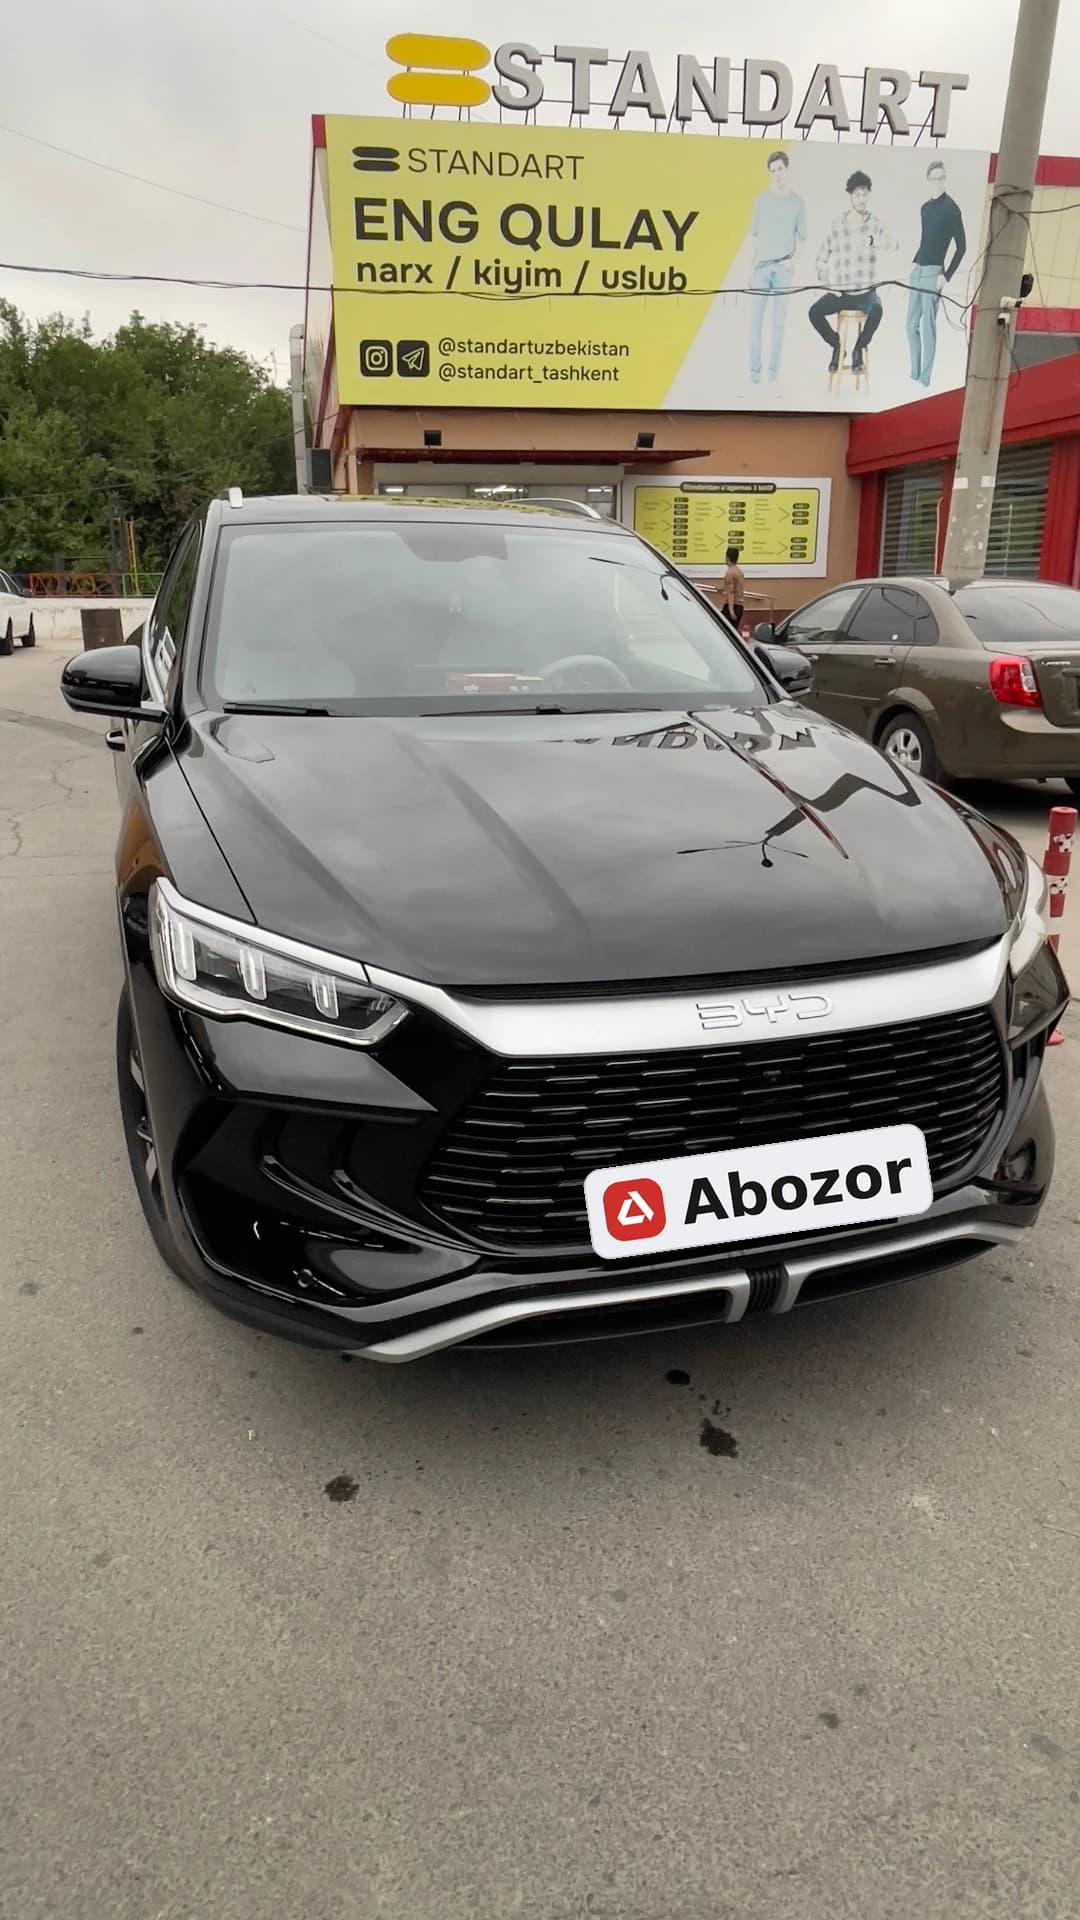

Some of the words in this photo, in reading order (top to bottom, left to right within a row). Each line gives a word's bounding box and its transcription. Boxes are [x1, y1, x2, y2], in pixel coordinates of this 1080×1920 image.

[491, 42, 969, 138] STANDART
[408, 147, 585, 180] STANDART
[354, 197, 479, 244] ENG
[500, 203, 700, 252] QULAY
[356, 260, 434, 284] narx
[446, 256, 461, 290] /
[474, 259, 562, 294] kiyim
[573, 260, 590, 294] /
[601, 265, 688, 292] uslub
[438, 337, 630, 357] @standartuzbekistan
[438, 362, 620, 383] @standart_tashkent
[696, 994, 833, 1030] BYD
